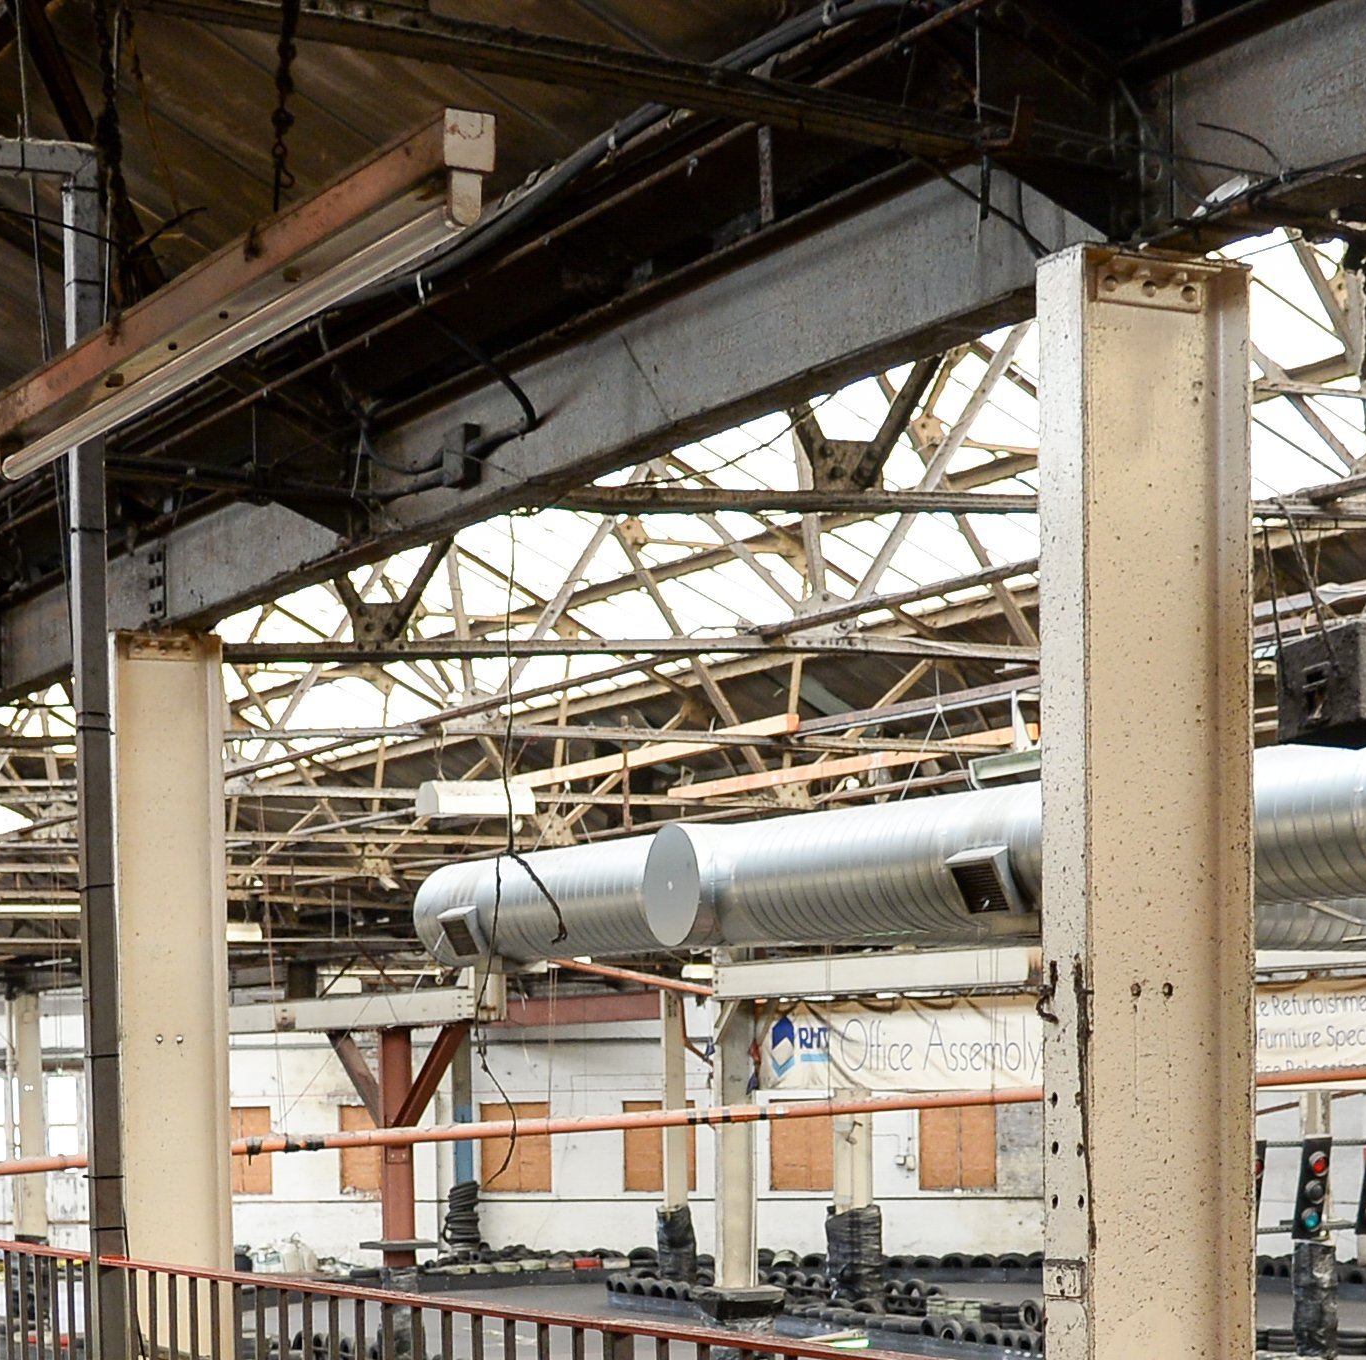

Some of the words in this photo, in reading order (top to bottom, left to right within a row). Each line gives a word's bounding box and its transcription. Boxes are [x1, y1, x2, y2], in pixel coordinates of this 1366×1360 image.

[841, 1018, 913, 1071] Office
[922, 1015, 1043, 1080] Assembly
[1258, 1026, 1321, 1049] Furniture
